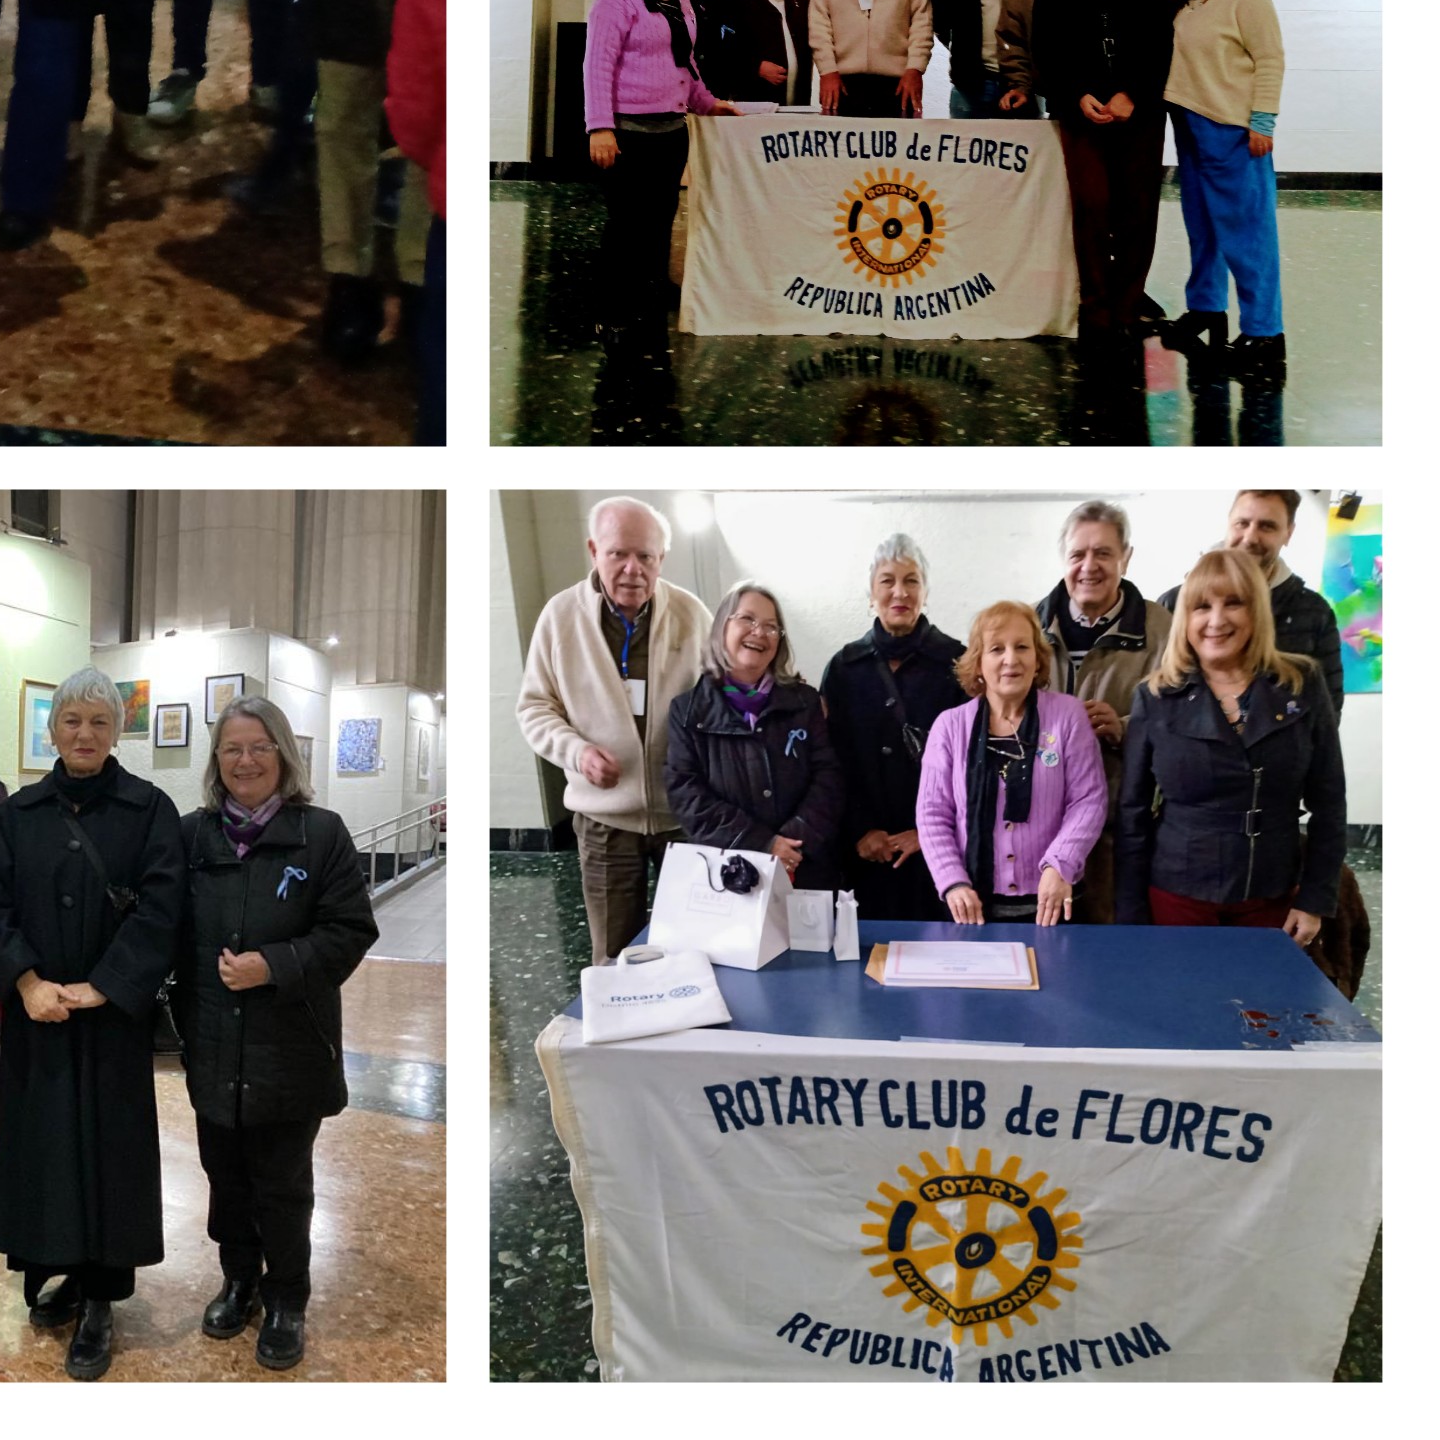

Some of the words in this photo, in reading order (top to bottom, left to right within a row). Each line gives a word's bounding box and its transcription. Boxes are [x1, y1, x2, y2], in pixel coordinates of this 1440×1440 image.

[761, 130, 841, 163] ROTARY
[846, 130, 897, 159] CLUB
[906, 132, 931, 161] de
[938, 134, 1029, 173] FLORES
[866, 184, 917, 200] ROTARY
[851, 240, 931, 275] INTERNATIONAL
[784, 276, 883, 318] REPUBLICA
[894, 272, 996, 320] ARGENTINA
[610, 992, 665, 1003] Rotary
[703, 1076, 868, 1133] ROTARY
[879, 1079, 986, 1130] CLUB
[1005, 1084, 1059, 1137] de
[1072, 1089, 1272, 1163] FLORES
[923, 1177, 1027, 1205] ROTARY
[897, 1263, 1049, 1325] INTERNATIONAL
[776, 1312, 955, 1382] REPUBLICA
[979, 1321, 1171, 1382] ARGENTINA
